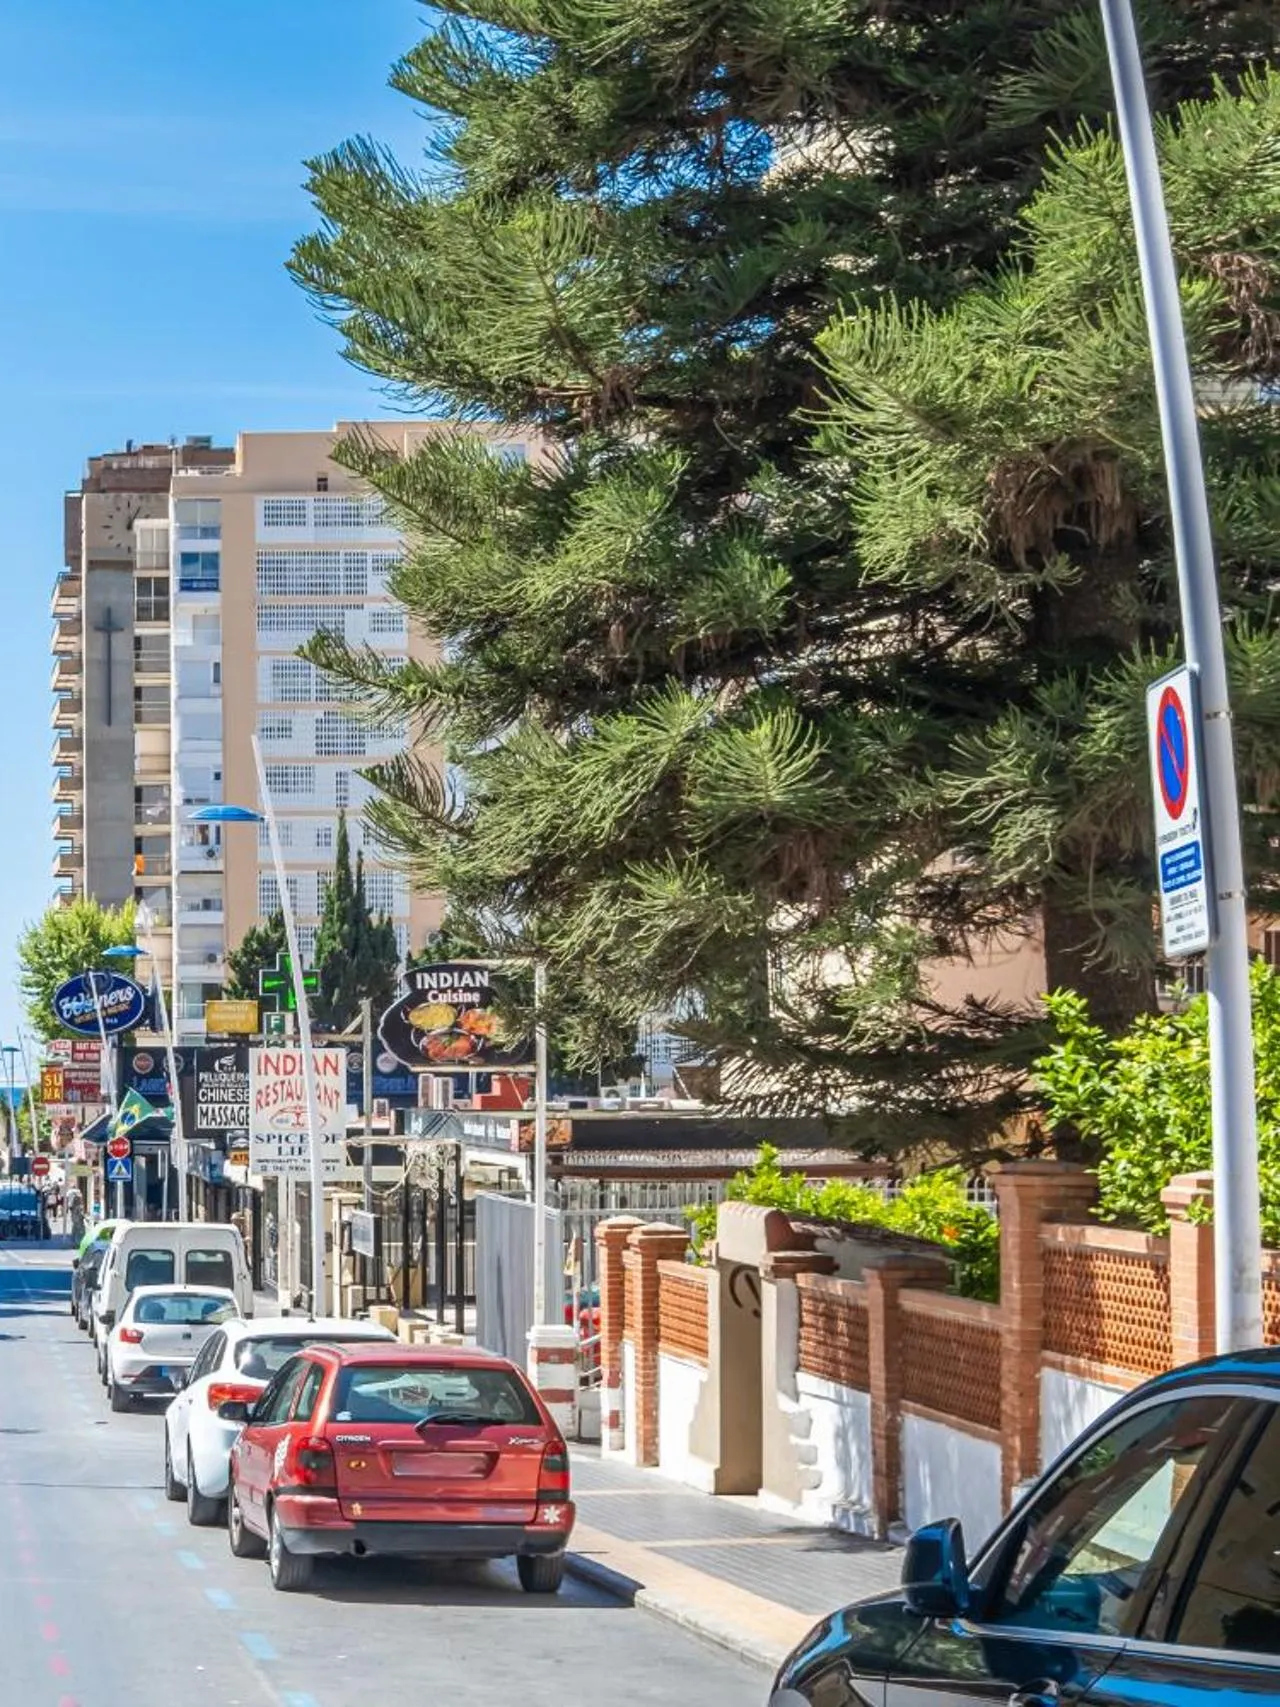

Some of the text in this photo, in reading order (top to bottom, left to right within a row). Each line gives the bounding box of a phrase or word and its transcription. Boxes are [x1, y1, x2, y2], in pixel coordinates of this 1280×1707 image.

[416, 971, 489, 989] INDIAN
[428, 989, 480, 1003] Cuisine
[199, 1089, 249, 1102] CHINESE
[255, 1079, 340, 1114] RESTAUANT
[199, 1106, 249, 1126] MASSAGE
[255, 1132, 310, 1144] SPICE
[278, 1145, 307, 1156] LIF
